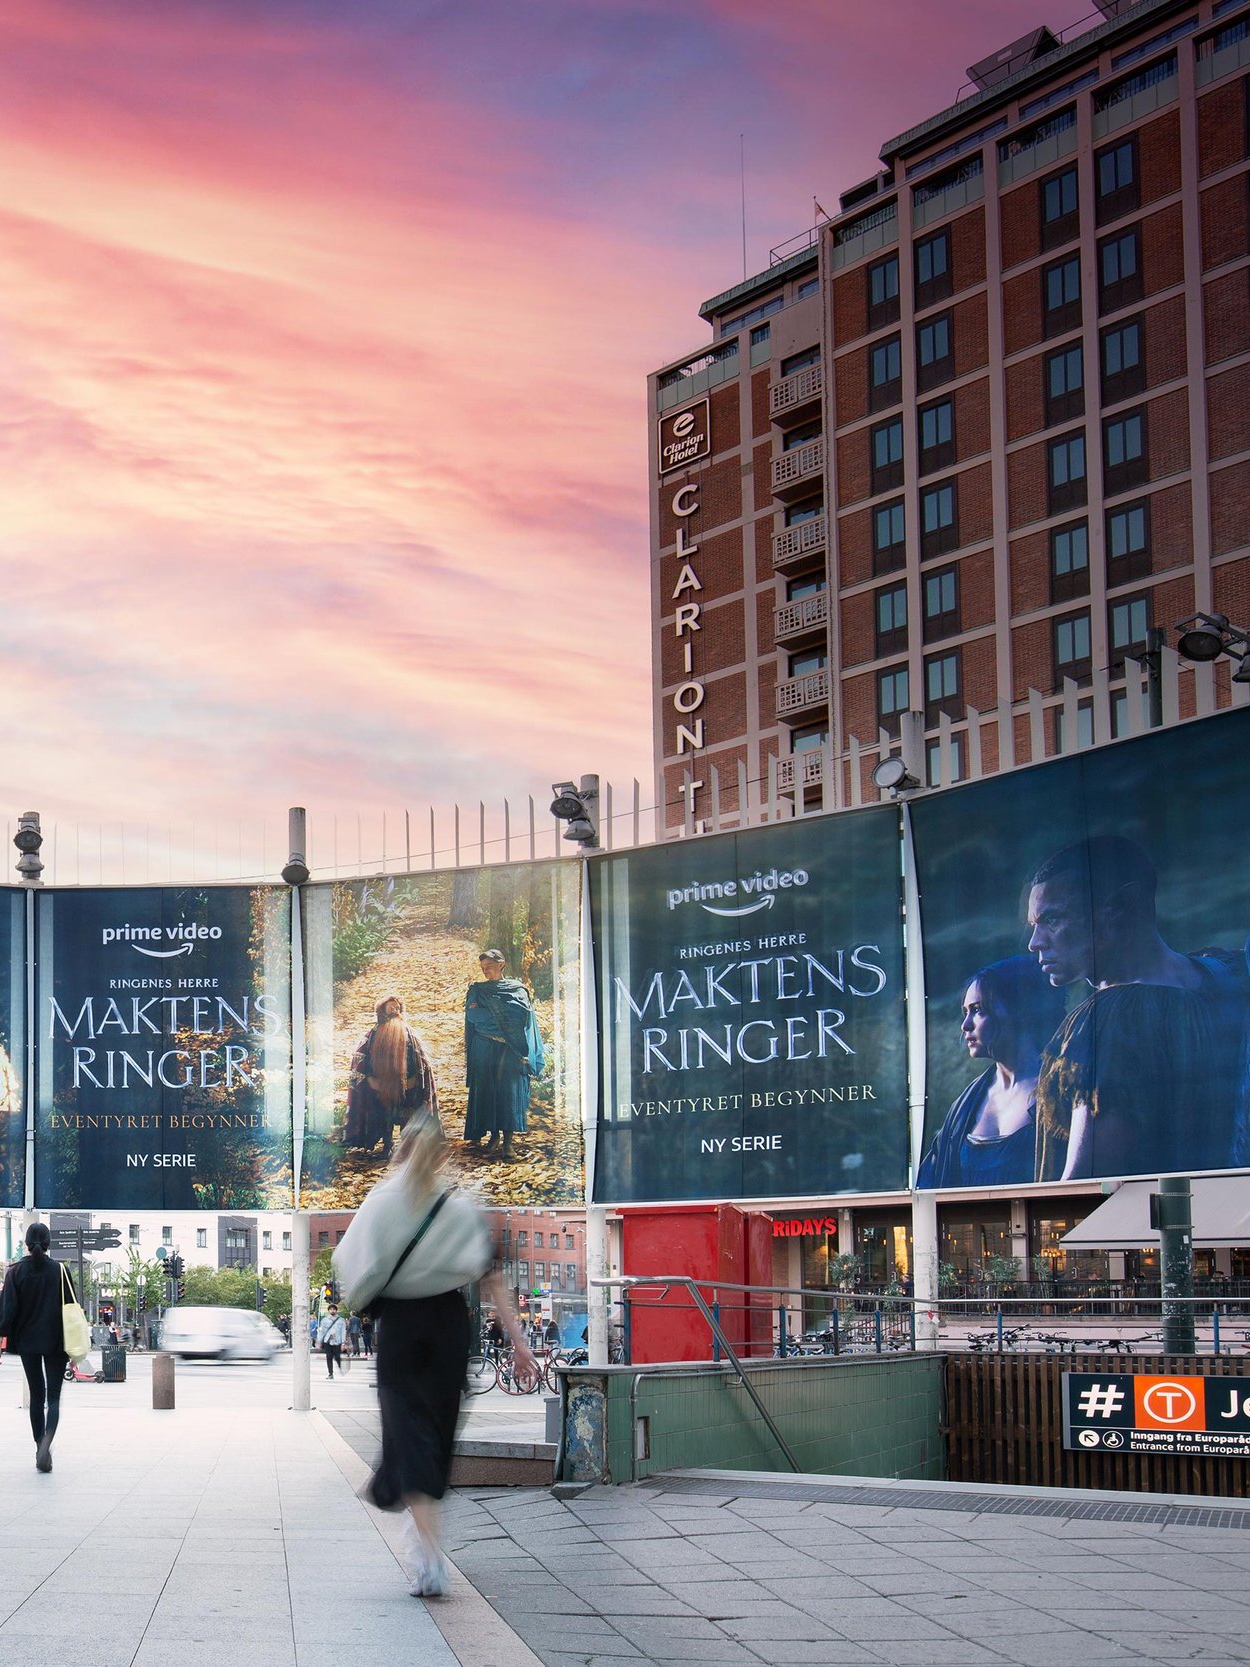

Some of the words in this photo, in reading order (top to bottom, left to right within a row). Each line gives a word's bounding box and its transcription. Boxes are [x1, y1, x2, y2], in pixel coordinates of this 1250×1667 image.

[663, 433, 704, 457] Clarion
[669, 443, 698, 465] Hotel
[671, 484, 705, 755] CLARION
[666, 880, 737, 911] prime
[740, 866, 810, 894] video
[102, 922, 162, 945] prime
[166, 922, 222, 941] video
[679, 940, 751, 959] RINGENES
[758, 932, 807, 949] HERRE
[109, 978, 172, 989] RINGENES
[178, 978, 219, 988] HERRE
[614, 944, 888, 1024] MAKTENS
[48, 995, 282, 1040] MAKTENS
[642, 1008, 857, 1074] RINGER
[71, 1045, 257, 1089] RINGER
[618, 1094, 743, 1118] EVENTYRET
[751, 1085, 878, 1109] BEGYNNER
[51, 1114, 162, 1129] EVENTYRET
[169, 1114, 273, 1129] BEGYNNER
[701, 1138, 727, 1153] NY
[731, 1135, 783, 1152] SERIE
[126, 1154, 148, 1168] NY
[153, 1153, 196, 1168] SERIE
[1130, 1431, 1174, 1443] Inngang
[1176, 1432, 1192, 1442] fra
[1130, 1441, 1174, 1451] Entrance
[1177, 1444, 1200, 1452] from
